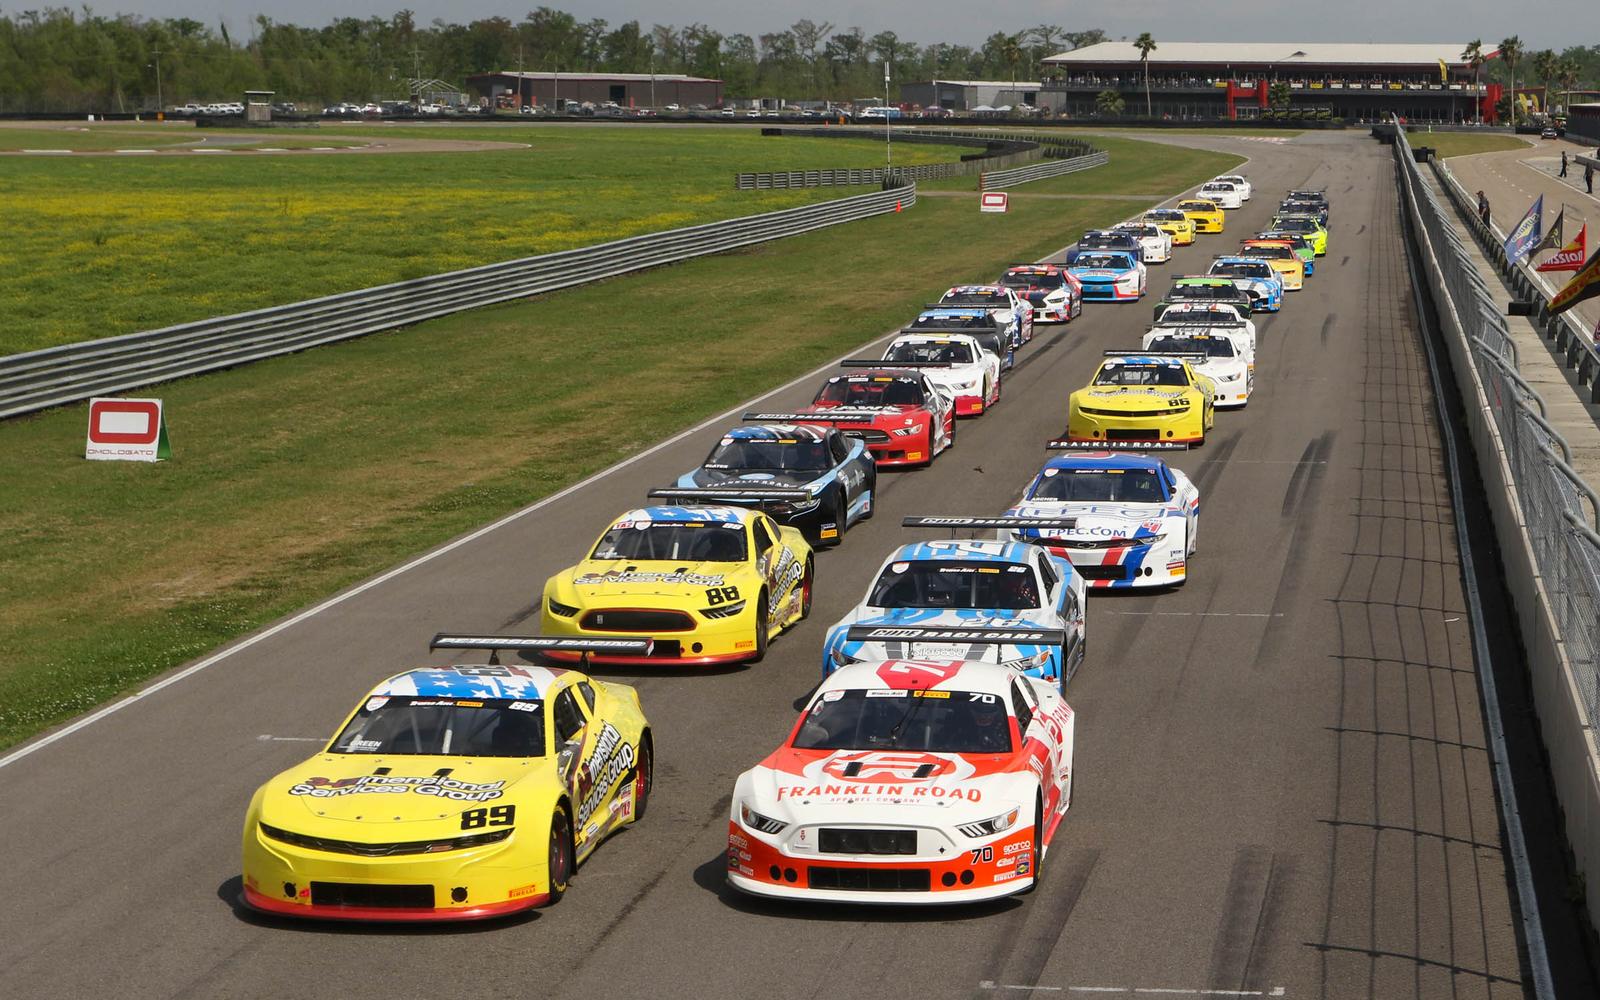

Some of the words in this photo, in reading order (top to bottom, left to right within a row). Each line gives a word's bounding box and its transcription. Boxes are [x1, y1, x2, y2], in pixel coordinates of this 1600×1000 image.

[706, 479, 759, 487] FRANKLIN
[761, 480, 790, 488] ROAD
[1047, 527, 1127, 538] FPEC.COM
[923, 630, 982, 639] RACE
[983, 631, 1044, 640] CARS
[968, 692, 996, 704] 70
[508, 701, 540, 713] 89
[288, 783, 411, 798] Services
[414, 785, 504, 802] Group
[776, 785, 904, 802] FRANKLIN
[912, 786, 982, 803] ROAD
[460, 804, 516, 831] 89
[1003, 840, 1031, 855] sparco
[970, 846, 993, 866] 70
